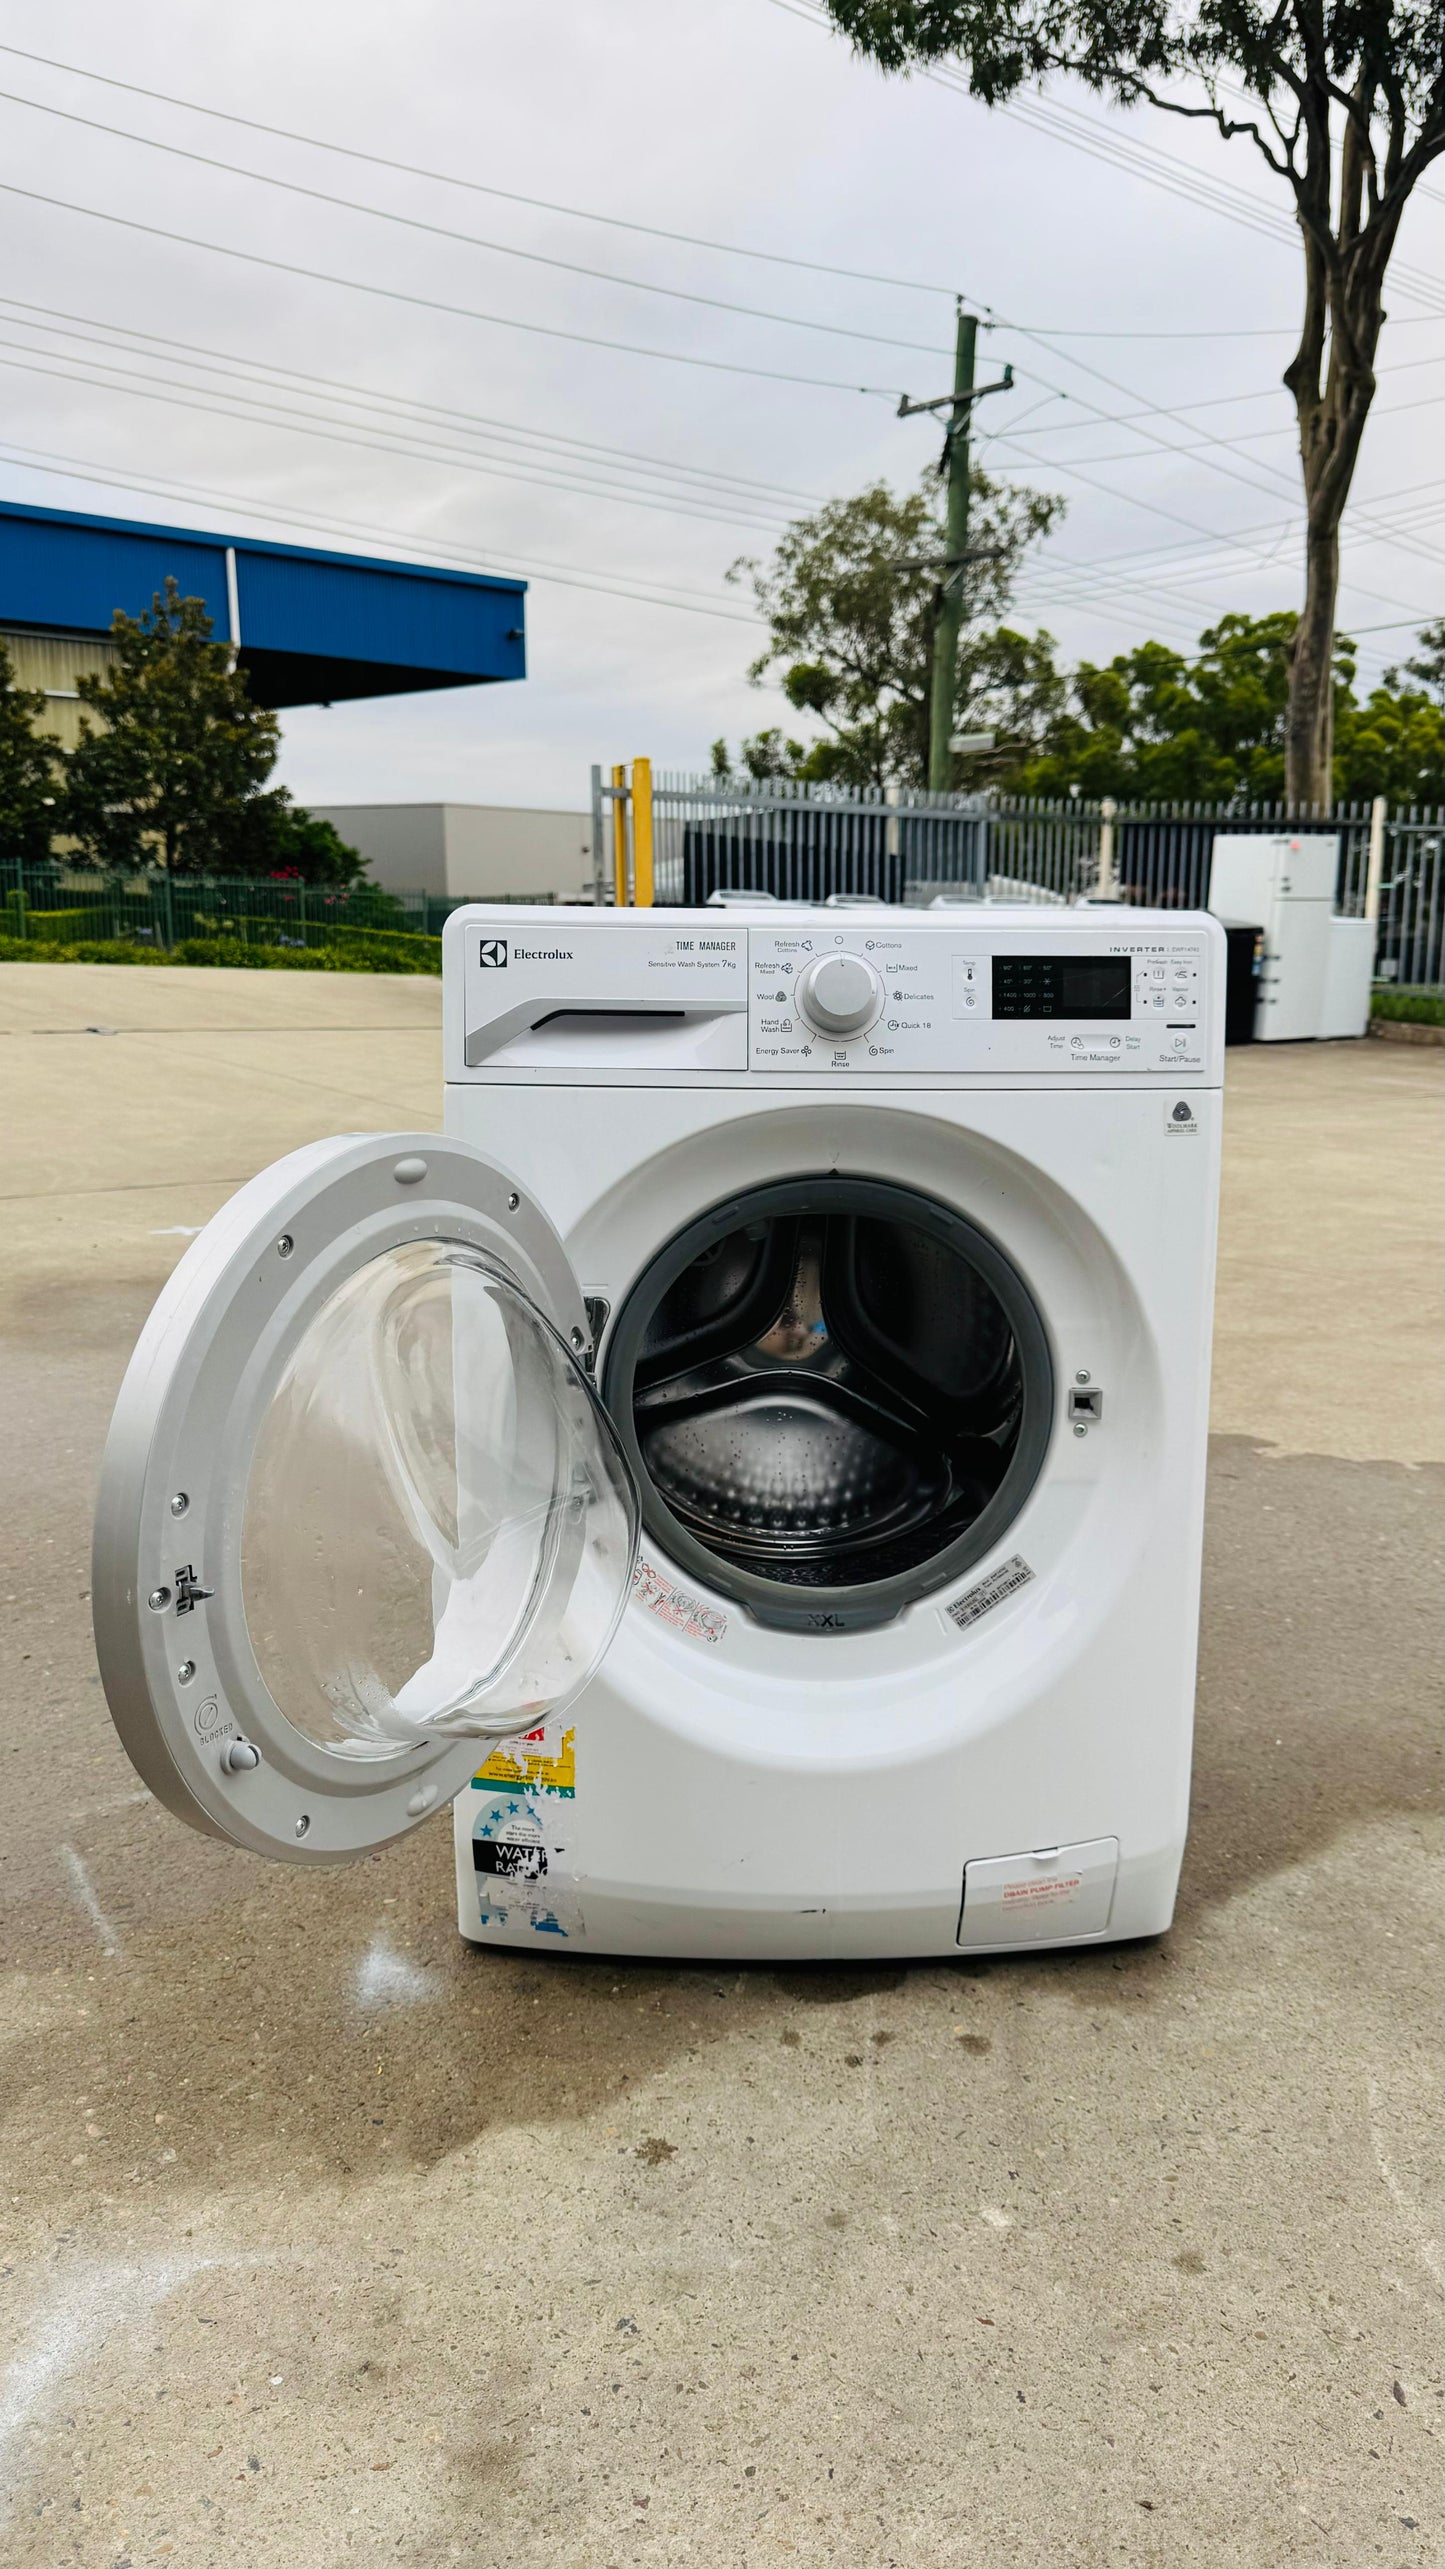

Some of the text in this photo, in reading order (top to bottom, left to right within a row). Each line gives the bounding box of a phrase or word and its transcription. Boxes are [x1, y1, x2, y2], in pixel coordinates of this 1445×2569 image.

[676, 941, 737, 951] TIME MANAGER
[774, 940, 800, 948] Refresh
[875, 941, 903, 949] Cottons
[513, 948, 574, 960] Electrolux
[648, 960, 676, 968] Sensitive
[677, 960, 696, 968] Wash
[697, 960, 720, 969] System
[898, 964, 919, 972] Mixed
[903, 992, 935, 1000] Delicates
[760, 1018, 779, 1026] Hand
[1124, 1035, 1142, 1043] Delay
[755, 1047, 779, 1056] Energy
[878, 1047, 895, 1056] Spin
[1070, 1053, 1121, 1063] Time Manager
[1159, 1054, 1201, 1063] Start/Pause
[831, 1060, 850, 1068] Rinse
[807, 1613, 845, 1627] XXL
[200, 1722, 233, 1746] BLOCKED
[1003, 1879, 1080, 1899] DRAIN PUMP FILTER
